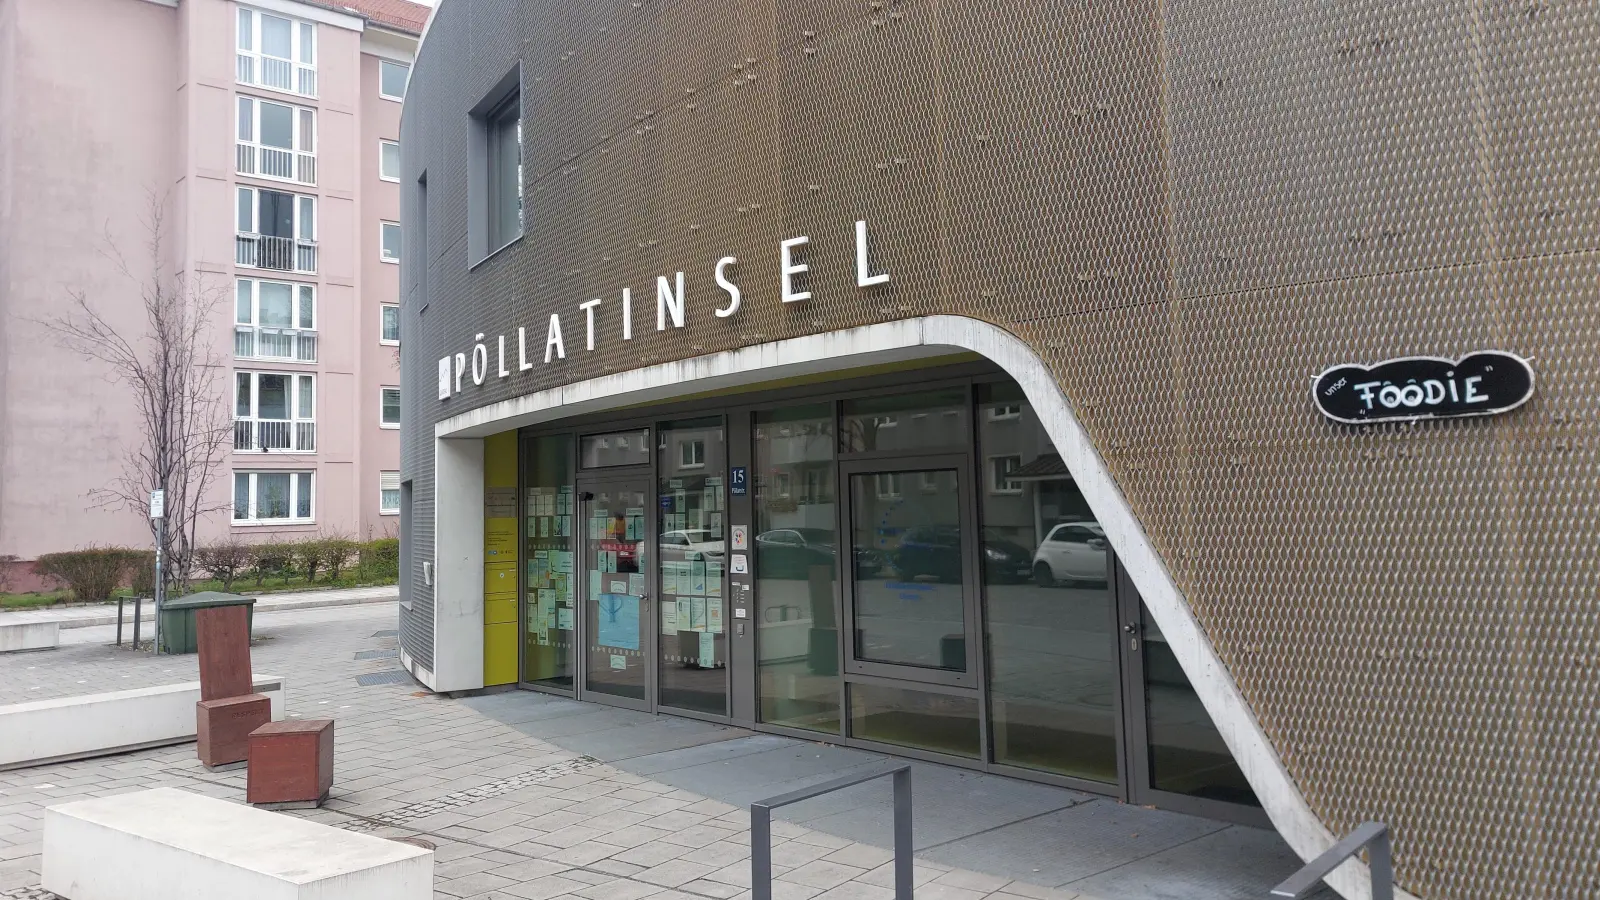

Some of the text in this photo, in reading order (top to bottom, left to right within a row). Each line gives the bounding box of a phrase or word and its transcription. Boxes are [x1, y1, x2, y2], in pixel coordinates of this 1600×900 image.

[455, 220, 889, 393] PÖLLATINSEL
[1325, 376, 1348, 396] unser
[732, 470, 744, 484] 15
